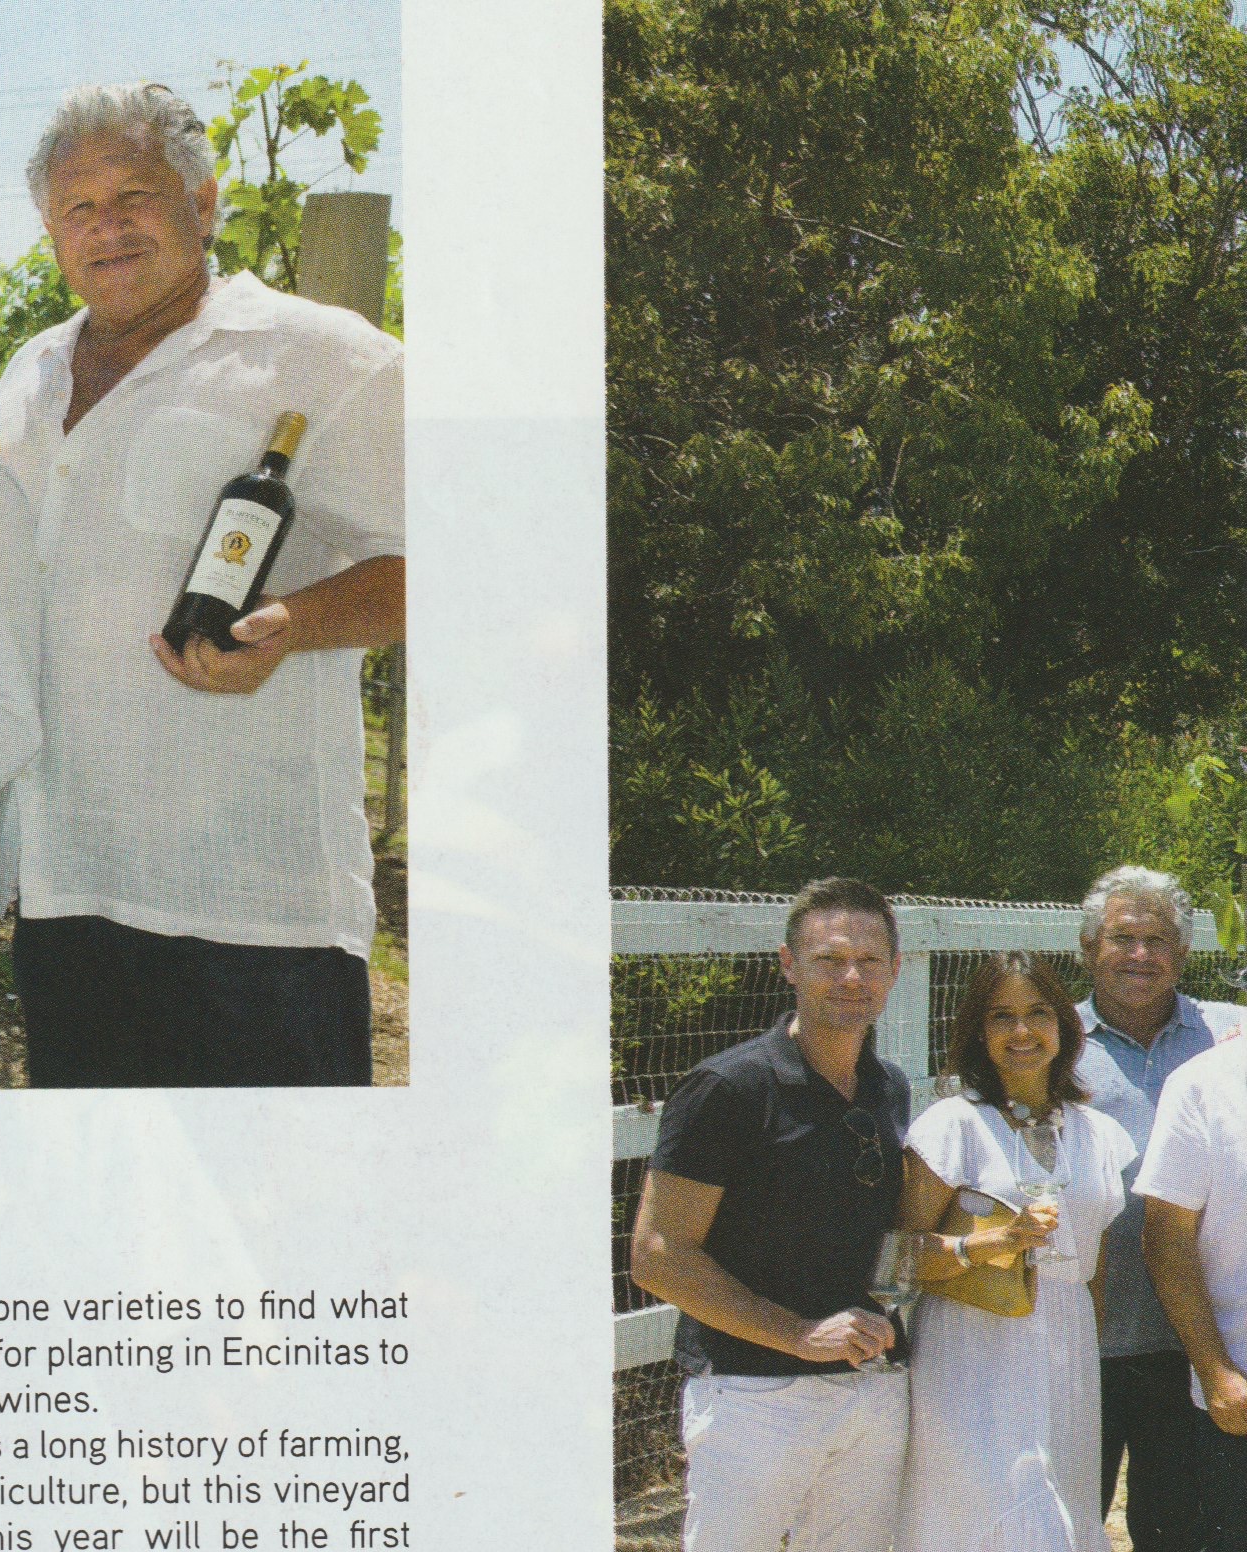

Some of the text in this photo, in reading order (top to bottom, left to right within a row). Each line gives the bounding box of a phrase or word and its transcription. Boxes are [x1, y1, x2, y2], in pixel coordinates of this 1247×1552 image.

[48, 1337, 174, 1376] planting
[185, 1336, 211, 1366] in
[223, 1336, 370, 1366] Encinitas
[379, 1338, 409, 1365] to
[142, 1474, 191, 1505] but
[203, 1474, 261, 1504] this
[273, 1472, 410, 1512] vineyard
